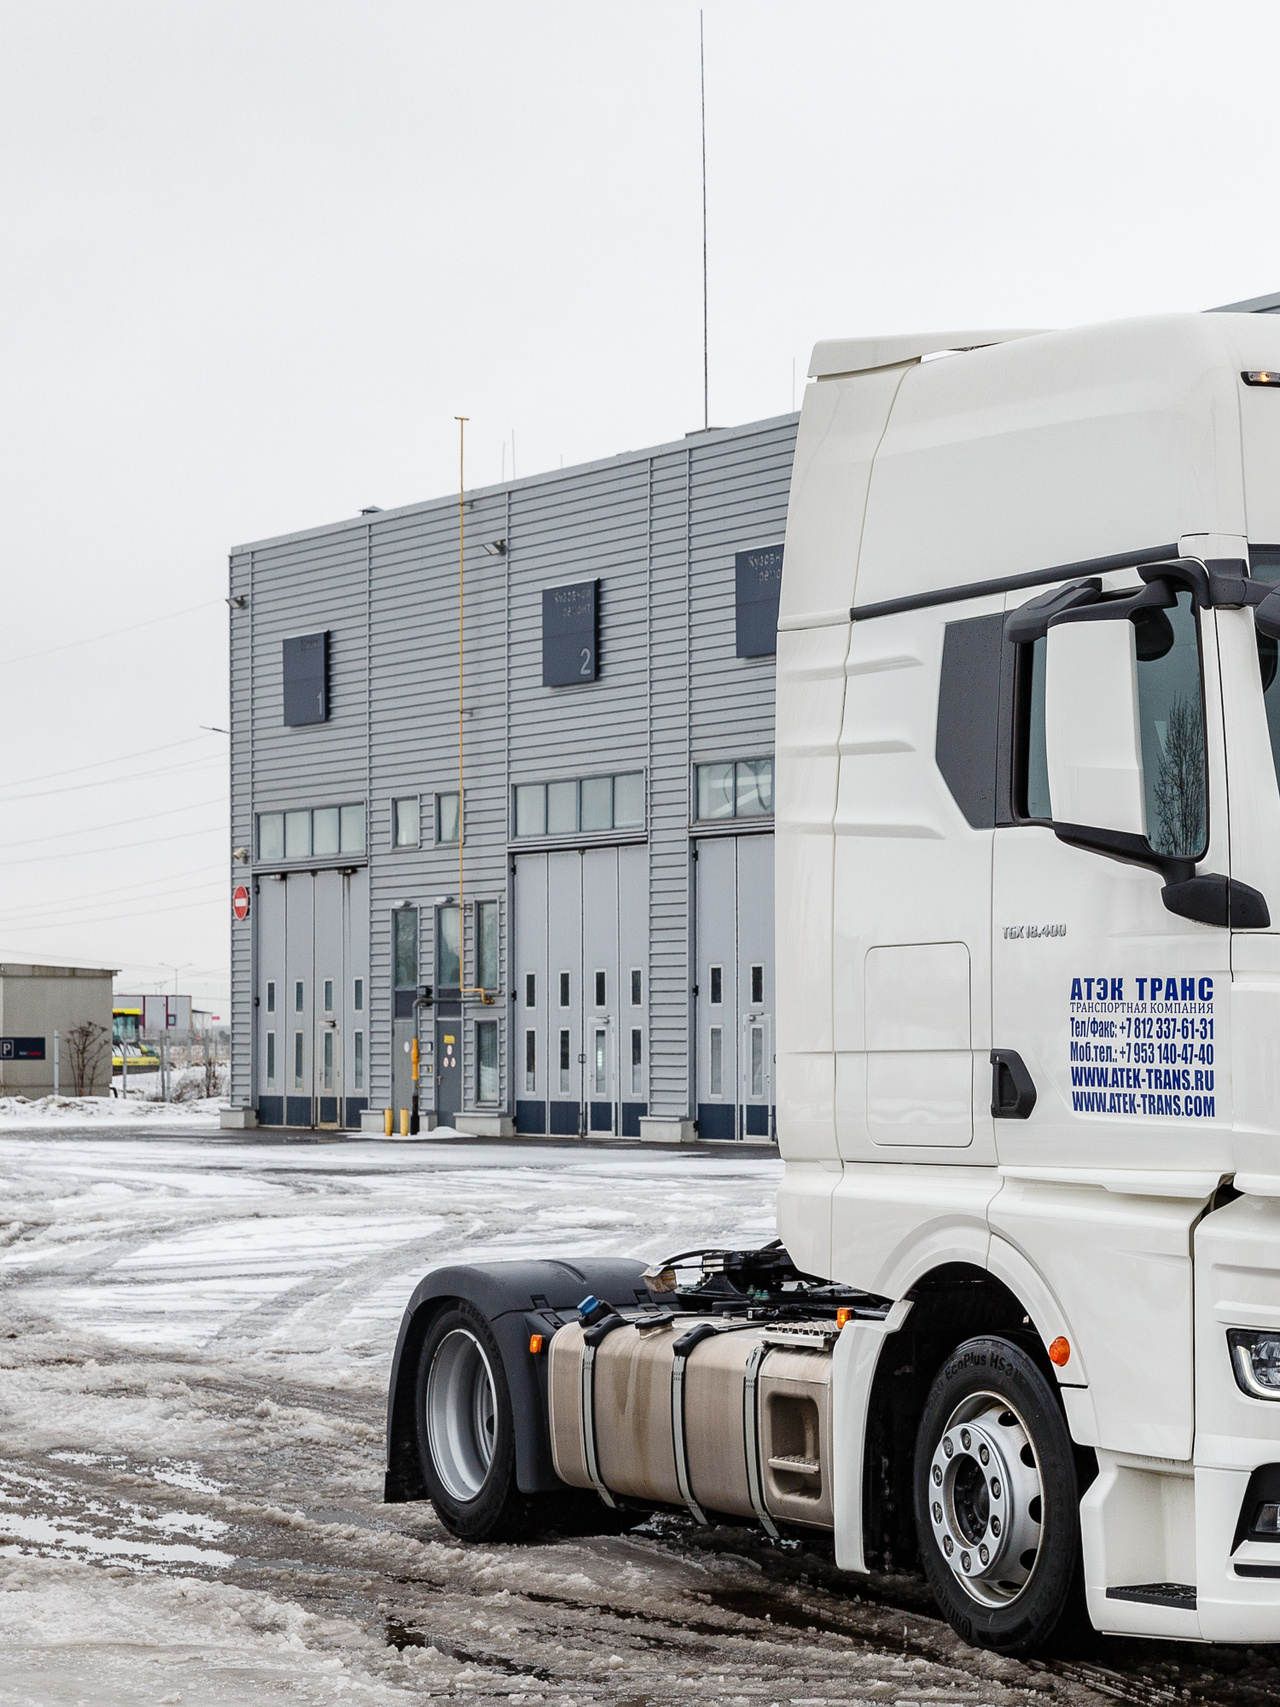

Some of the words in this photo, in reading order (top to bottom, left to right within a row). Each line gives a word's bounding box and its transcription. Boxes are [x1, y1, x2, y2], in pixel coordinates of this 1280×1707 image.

[580, 647, 592, 675] 2
[316, 691, 323, 715] 1
[1002, 925, 1025, 940] TGX
[1025, 923, 1067, 939] 18.400
[1069, 977, 1124, 1001] АТЭК
[1135, 976, 1214, 1001] ТРАНС
[1069, 1002, 1147, 1013] ТРАНСПОРТНАЯ
[1150, 1002, 1214, 1014] КОМПАНИЯ
[1069, 1016, 1118, 1039] Тел/Факс:
[1119, 1017, 1132, 1039] +7
[1134, 1017, 1153, 1039] 812
[1155, 1017, 1214, 1040] 337-61-31
[3, 1042, 11, 1055] P
[1069, 1041, 1118, 1063] Моб.тел.:
[1119, 1042, 1132, 1064] +7
[1133, 1042, 1155, 1064] 953
[1156, 1043, 1214, 1065] 140-47-40
[1070, 1066, 1215, 1091] WWW.ATEK-TRANS.RU
[1071, 1090, 1216, 1118] WWW.ATEK-TRANS.COM
[944, 1350, 988, 1381] EcoPlus
